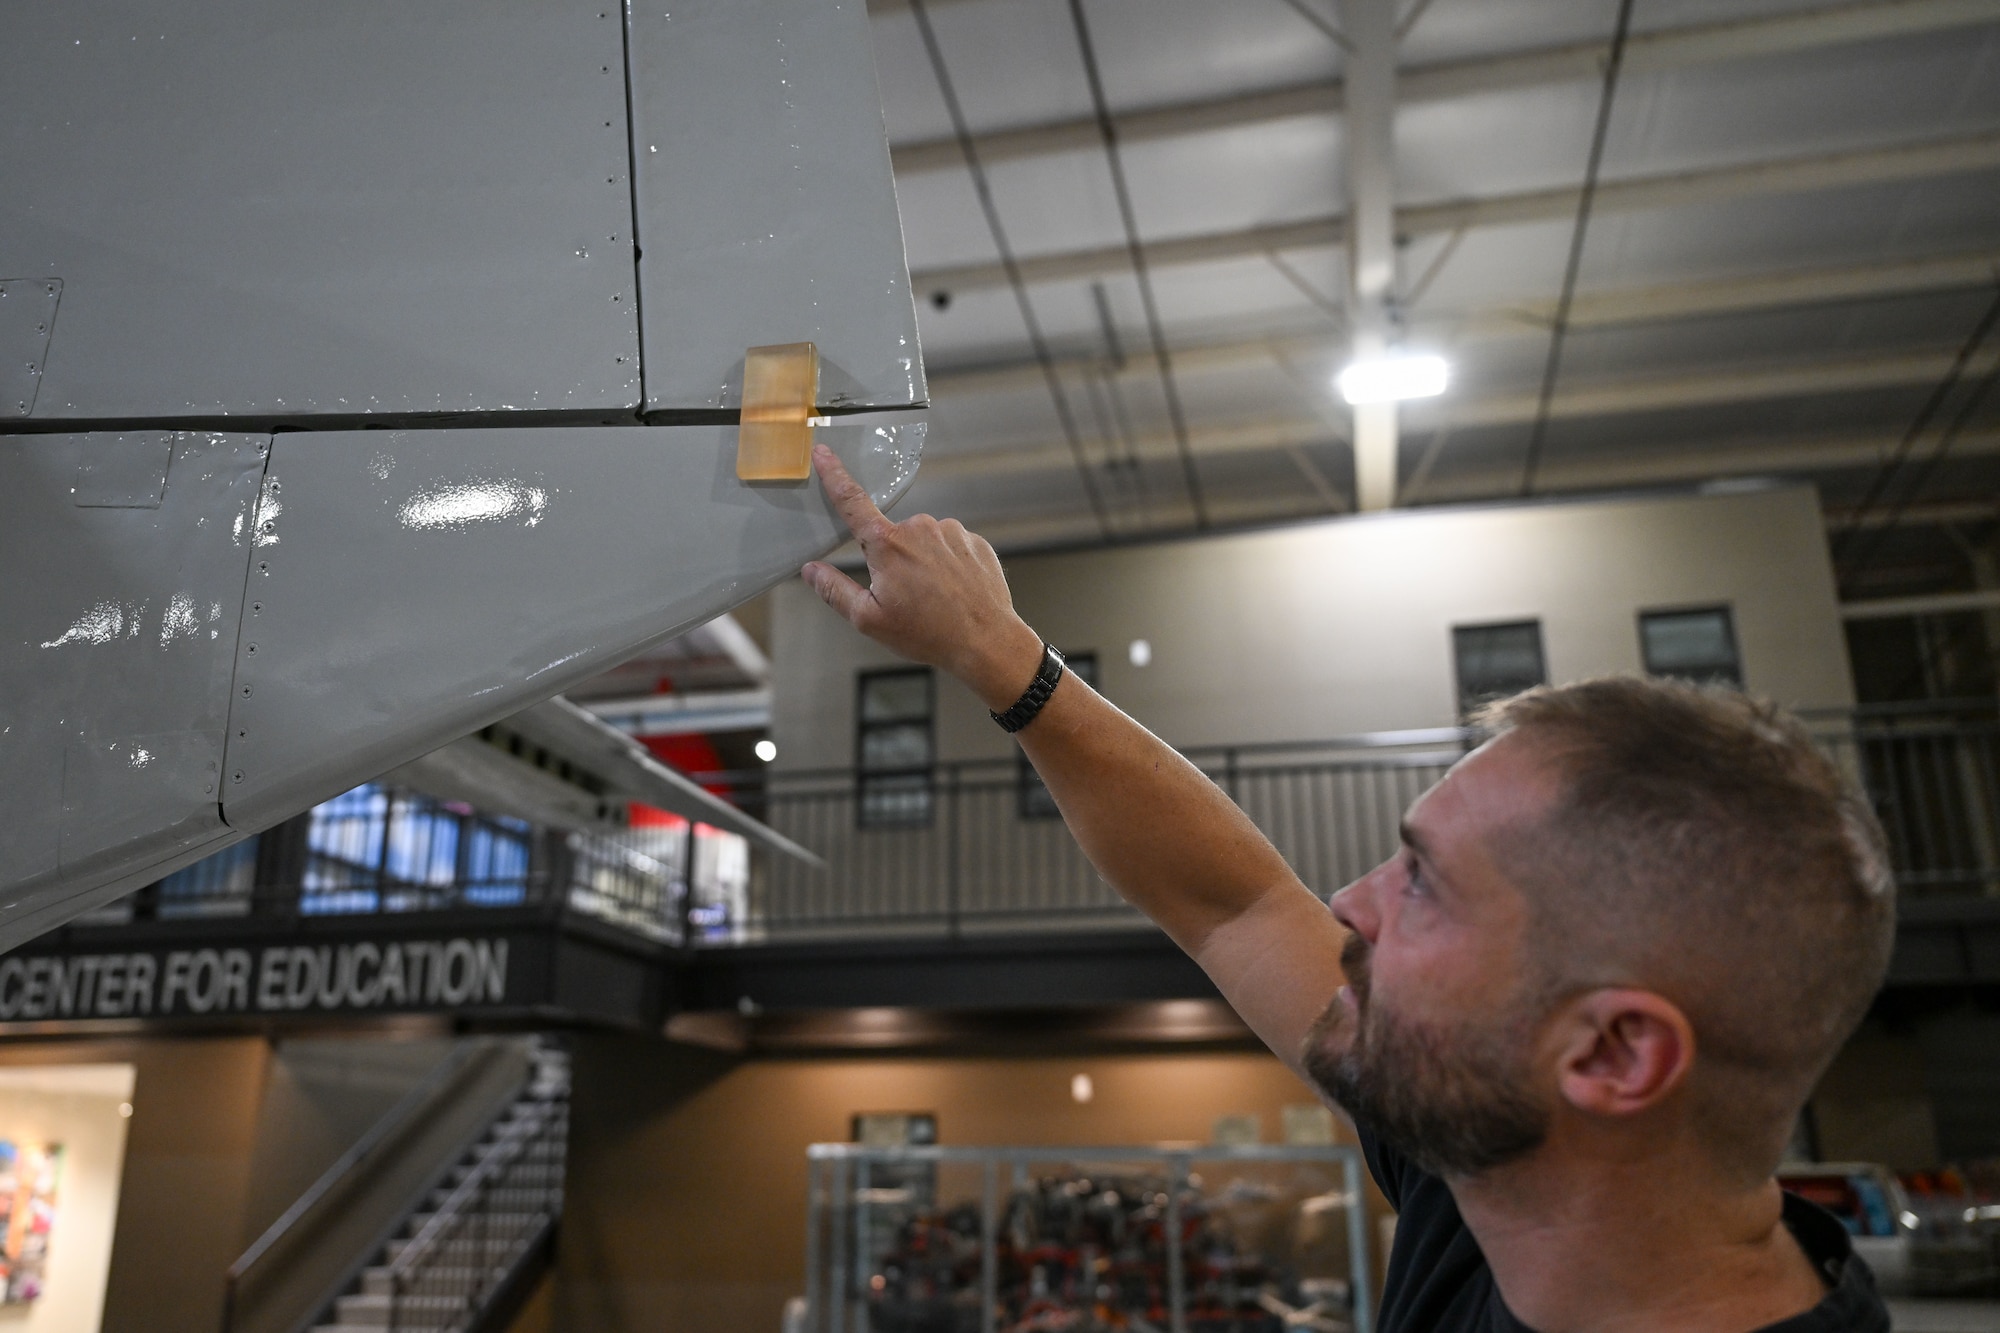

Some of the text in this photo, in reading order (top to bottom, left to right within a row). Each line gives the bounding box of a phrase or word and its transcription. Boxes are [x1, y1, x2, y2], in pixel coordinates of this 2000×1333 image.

[0, 939, 508, 1018] CENTER FOR EDUCATION
